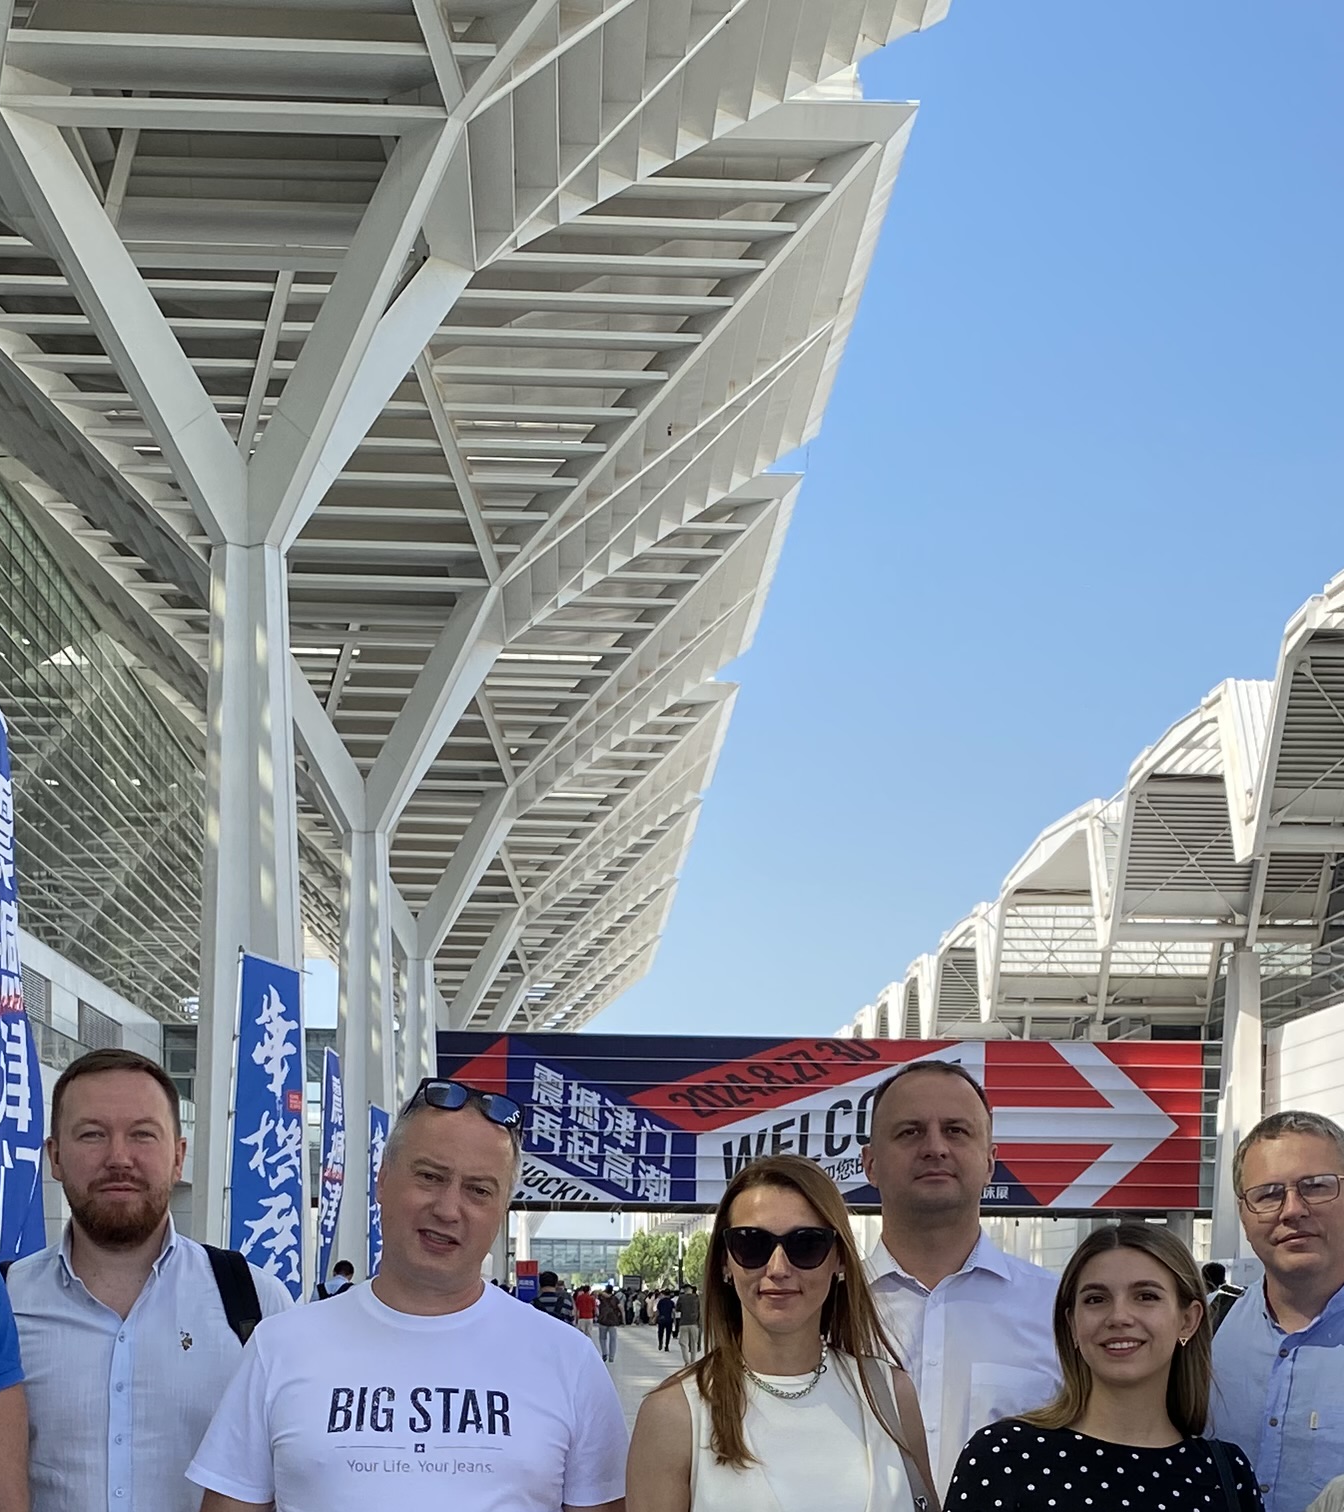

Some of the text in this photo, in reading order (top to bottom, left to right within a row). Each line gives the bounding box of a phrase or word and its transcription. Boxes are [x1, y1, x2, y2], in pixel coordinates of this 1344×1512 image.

[531, 1062, 673, 1169] 震撼津门
[530, 1105, 673, 1202] 再起高潮
[981, 1186, 1009, 1199] 床展
[327, 1386, 512, 1437] BIG STAR
[346, 1459, 379, 1473] Your
[419, 1459, 449, 1473] Your
[452, 1459, 495, 1475] Jeans.
